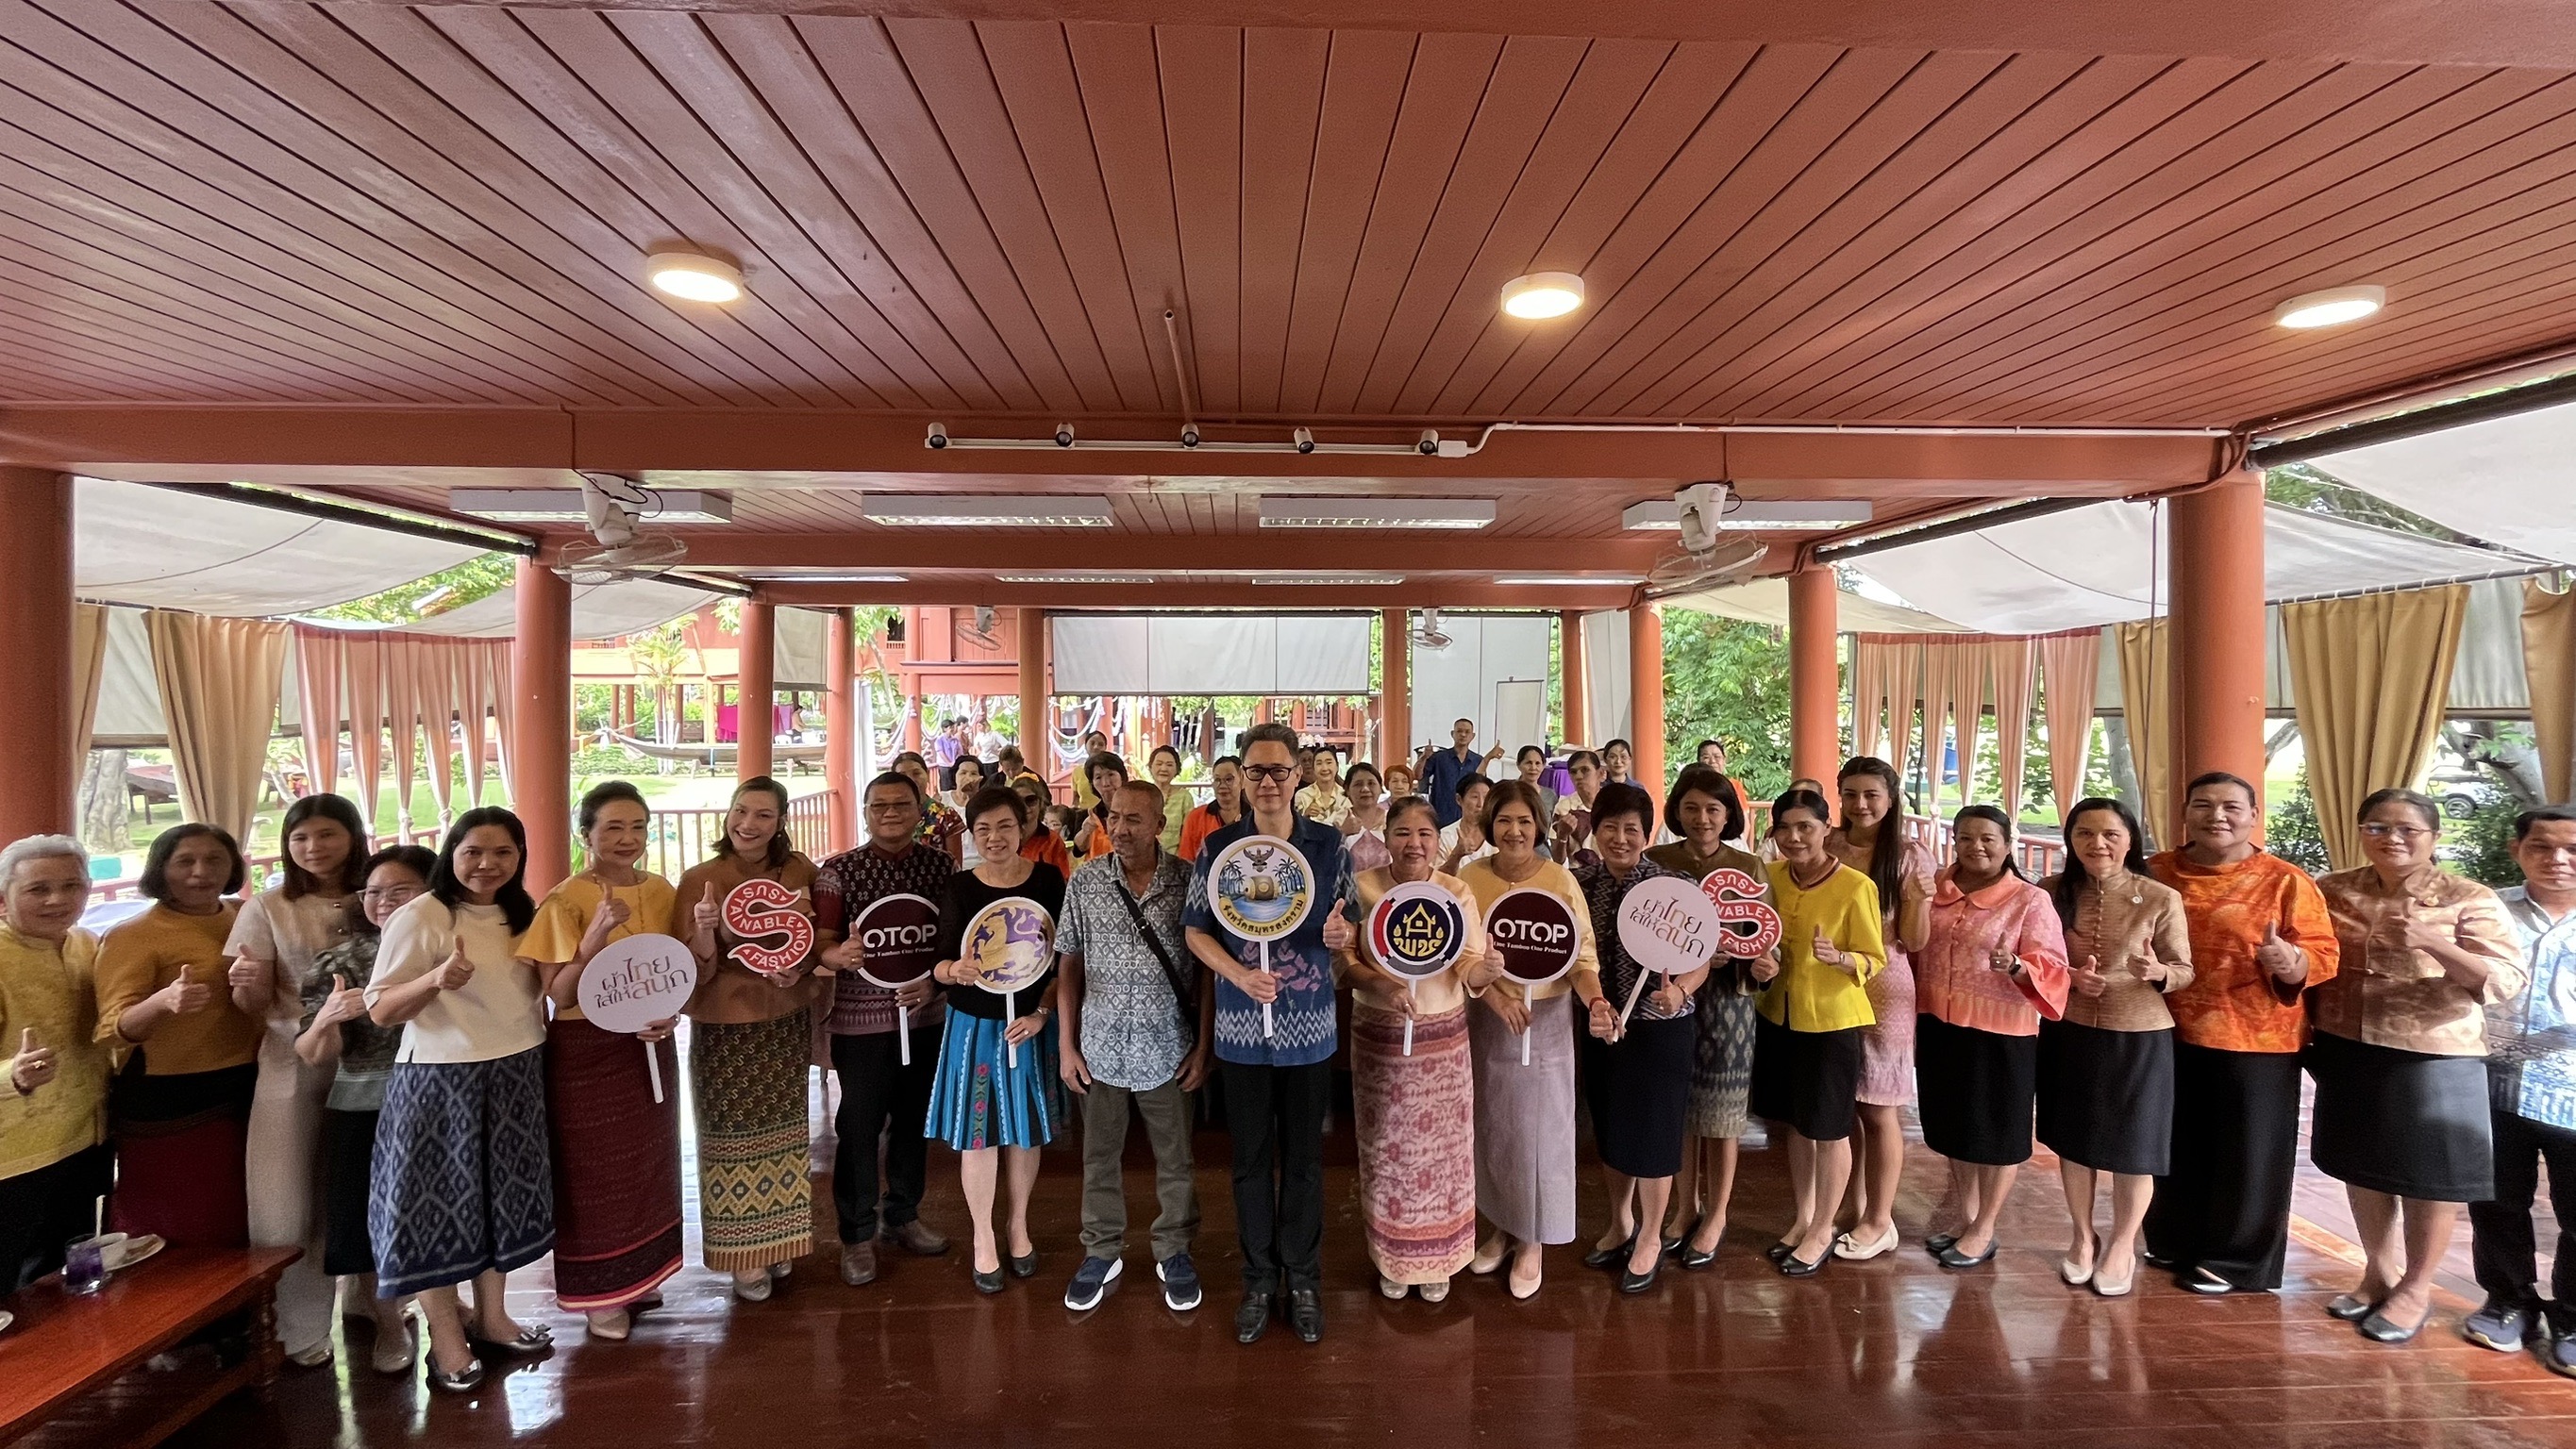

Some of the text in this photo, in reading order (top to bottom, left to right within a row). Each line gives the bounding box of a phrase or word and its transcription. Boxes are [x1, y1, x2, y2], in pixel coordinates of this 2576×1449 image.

[729, 885, 797, 931] SUSTAINABLE
[1643, 896, 1703, 935] ผ้าไทย
[748, 928, 808, 968] FASHION
[862, 924, 937, 949] OTOP
[1494, 918, 1568, 943] OTOP
[1630, 906, 1704, 958] ใส่ให้สนุก
[594, 969, 689, 1008] ใส่ให้สนุก
[602, 956, 671, 991] ผ้าไทย
